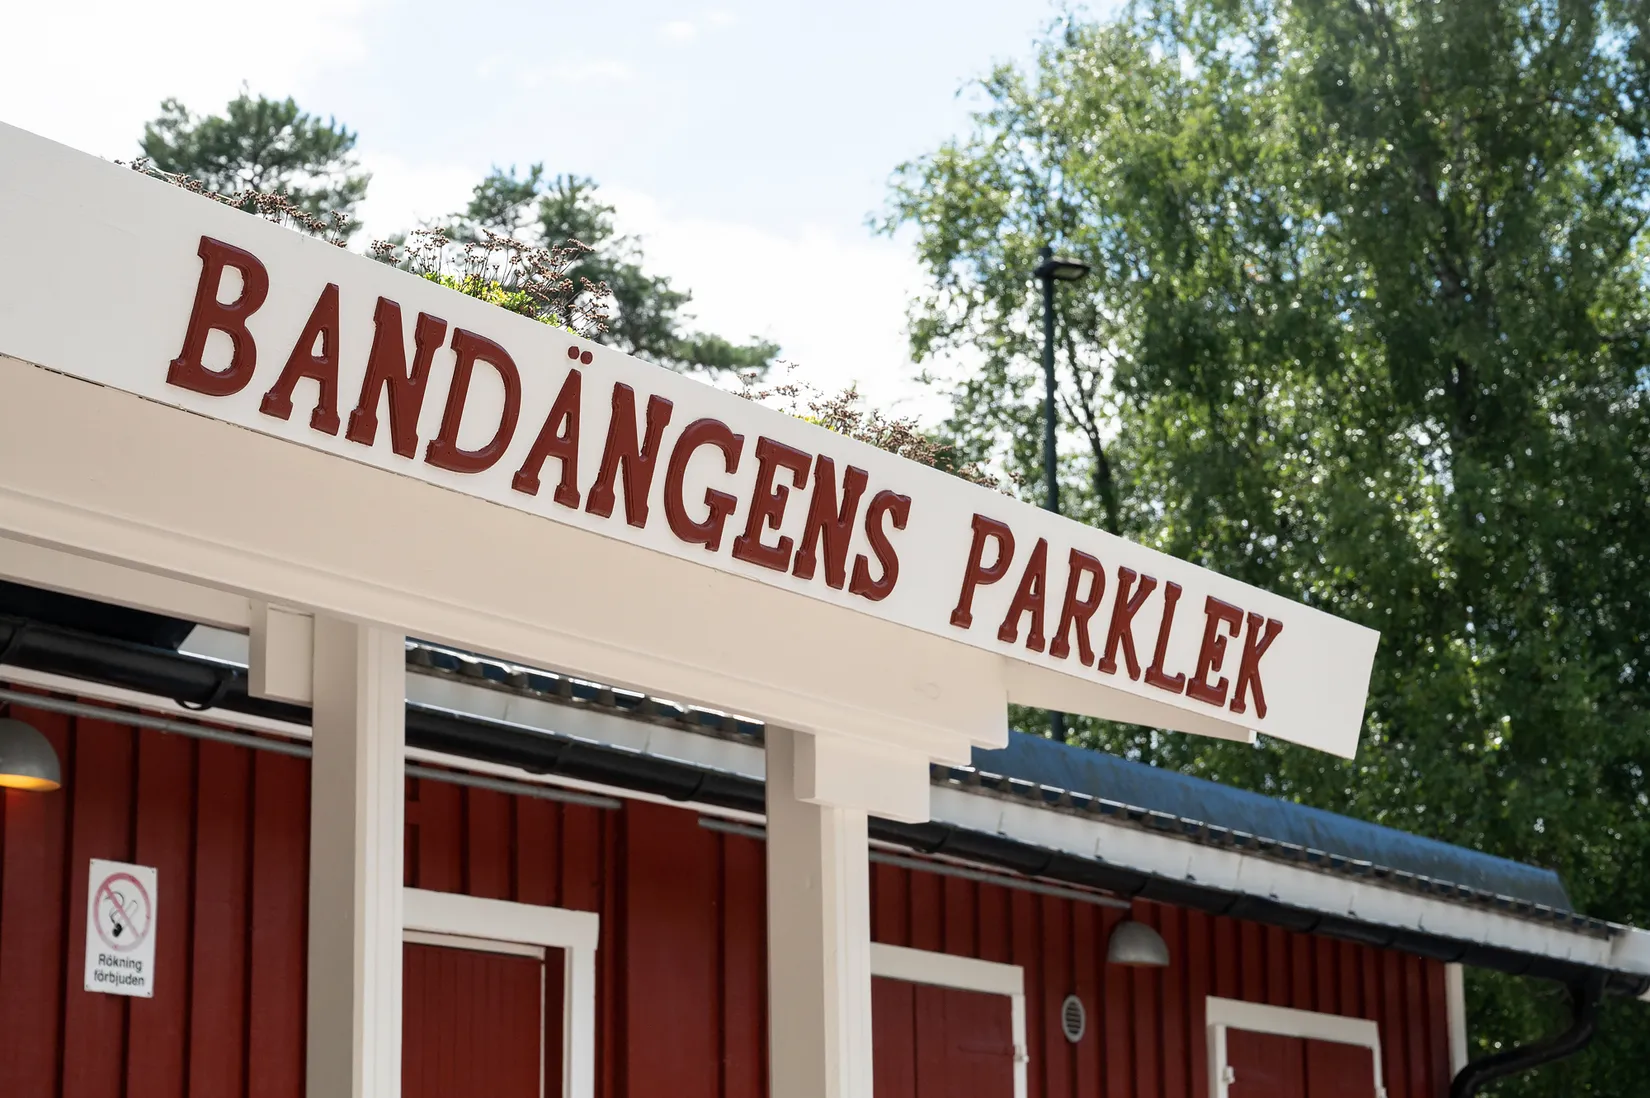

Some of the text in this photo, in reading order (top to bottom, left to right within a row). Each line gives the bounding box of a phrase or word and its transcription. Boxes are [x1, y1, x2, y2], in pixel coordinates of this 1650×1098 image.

[168, 236, 1284, 719] BANDÄNGENS PARKLEK
[98, 953, 143, 973] Rökning
[94, 969, 145, 987] förbjuden
